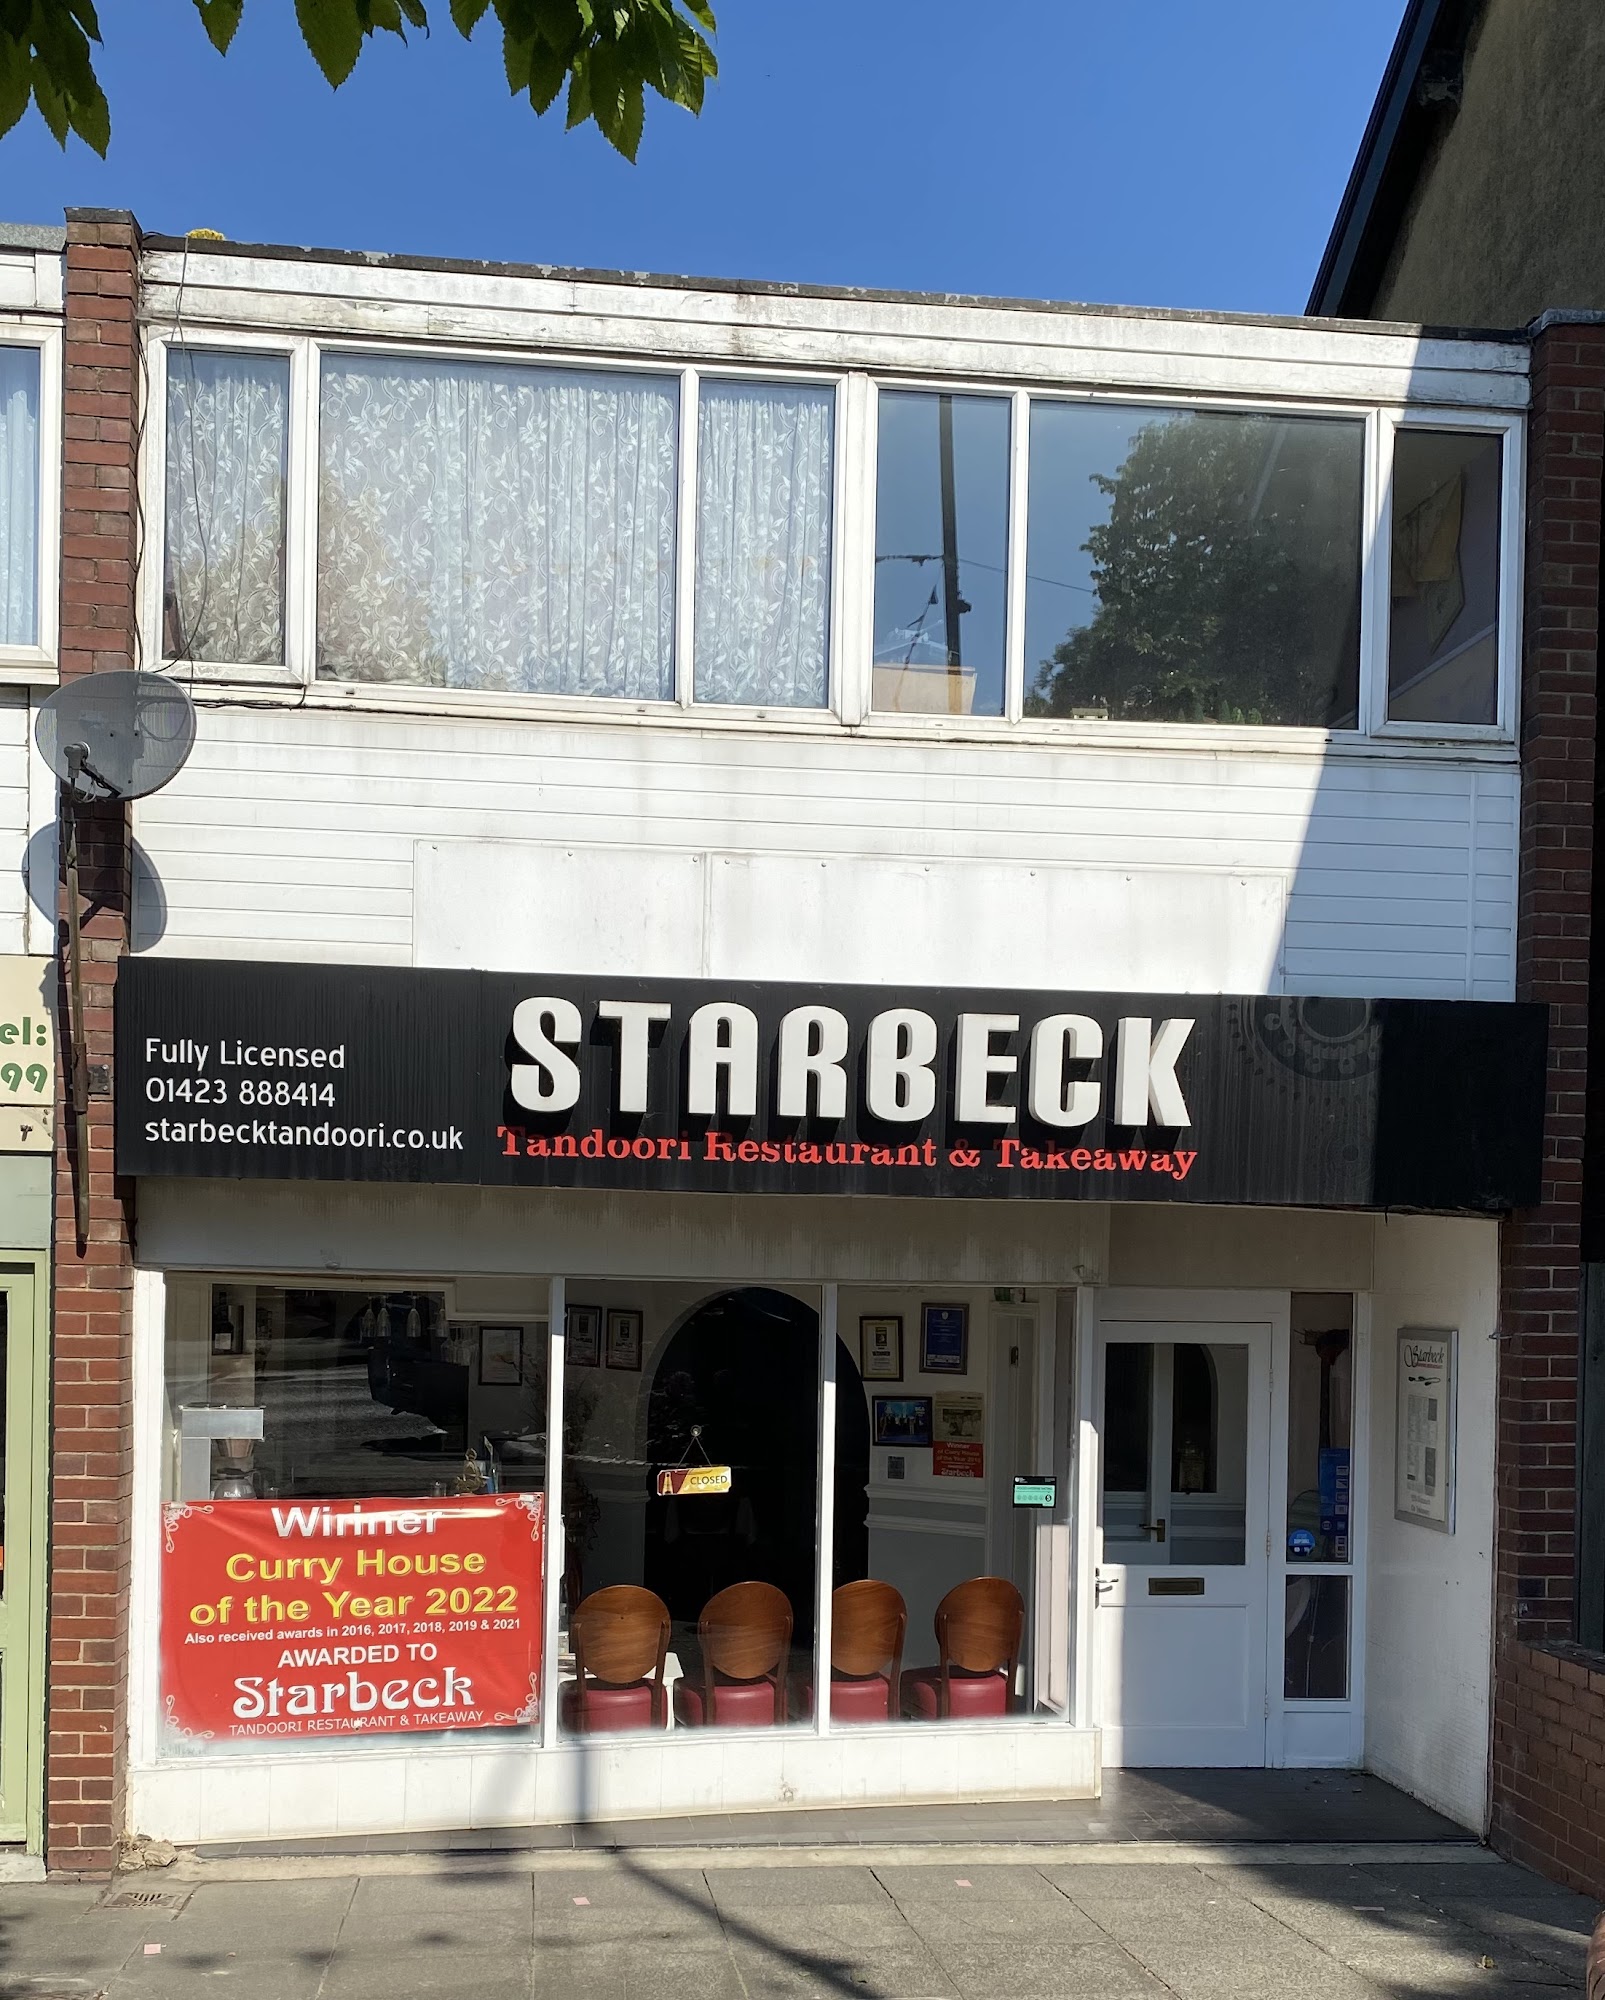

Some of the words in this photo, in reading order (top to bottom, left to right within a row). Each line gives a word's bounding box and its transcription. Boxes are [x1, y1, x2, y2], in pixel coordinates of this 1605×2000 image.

[146, 1038, 209, 1071] Fully
[220, 1040, 345, 1068] Licensed
[511, 996, 1195, 1128] STARBECK
[145, 1077, 228, 1104] 01423
[238, 1080, 336, 1107] 888414
[144, 1118, 464, 1150] starbecktandoori.co.uk
[497, 1125, 692, 1161] Tandoori
[703, 1131, 938, 1167] Restaurant
[948, 1138, 981, 1168] &
[996, 1139, 1198, 1180] Takeaway
[690, 1475, 728, 1485] CLOSED
[271, 1506, 443, 1538] Winner
[226, 1553, 343, 1585] Curry
[357, 1549, 486, 1577] House
[190, 1596, 233, 1625] of
[244, 1594, 311, 1624] the
[322, 1590, 415, 1619] Year
[425, 1585, 518, 1616] 2022
[184, 1632, 215, 1645] Also
[218, 1629, 274, 1642] received
[276, 1626, 323, 1640] awards
[326, 1625, 339, 1637] in
[341, 1624, 375, 1637] 2016,
[378, 1622, 411, 1636] 2017,
[413, 1621, 446, 1634] 2018,
[449, 1620, 478, 1632] 2019
[480, 1619, 490, 1631] &
[493, 1618, 520, 1631] 2021
[277, 1644, 400, 1669] AWARDED
[405, 1642, 438, 1662] TO
[233, 1666, 475, 1719] Starbeck
[229, 1720, 303, 1737] TANDOORI
[307, 1715, 397, 1732] RESTAURANT
[399, 1714, 410, 1727] &
[413, 1710, 484, 1726] TAKEAWAY
